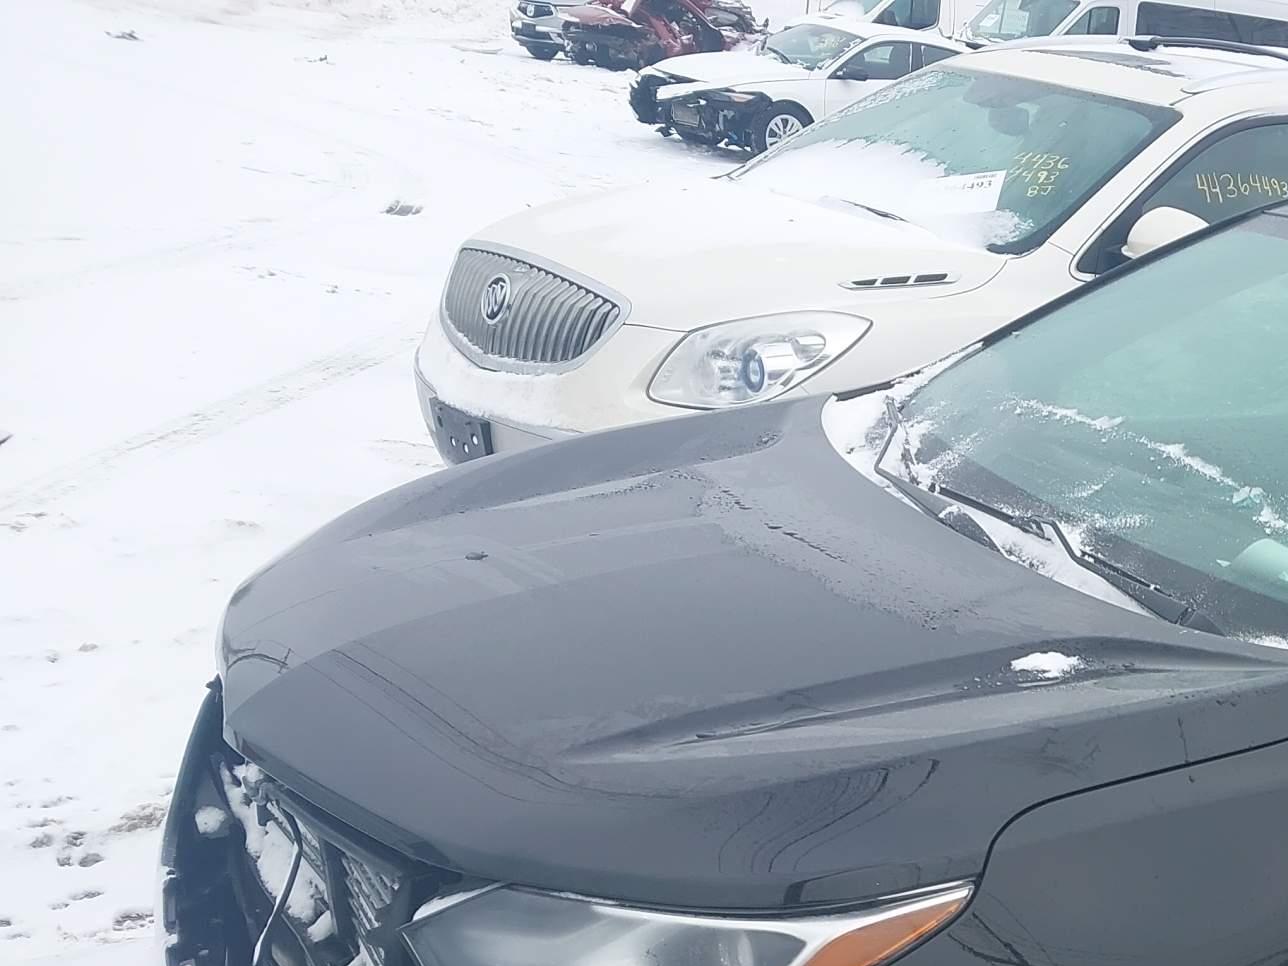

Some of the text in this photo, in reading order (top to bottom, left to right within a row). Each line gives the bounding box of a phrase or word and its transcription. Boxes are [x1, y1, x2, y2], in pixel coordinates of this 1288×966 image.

[1013, 151, 1070, 170] 4436
[1005, 166, 1061, 184] 4493
[1195, 171, 1288, 204] 44364493
